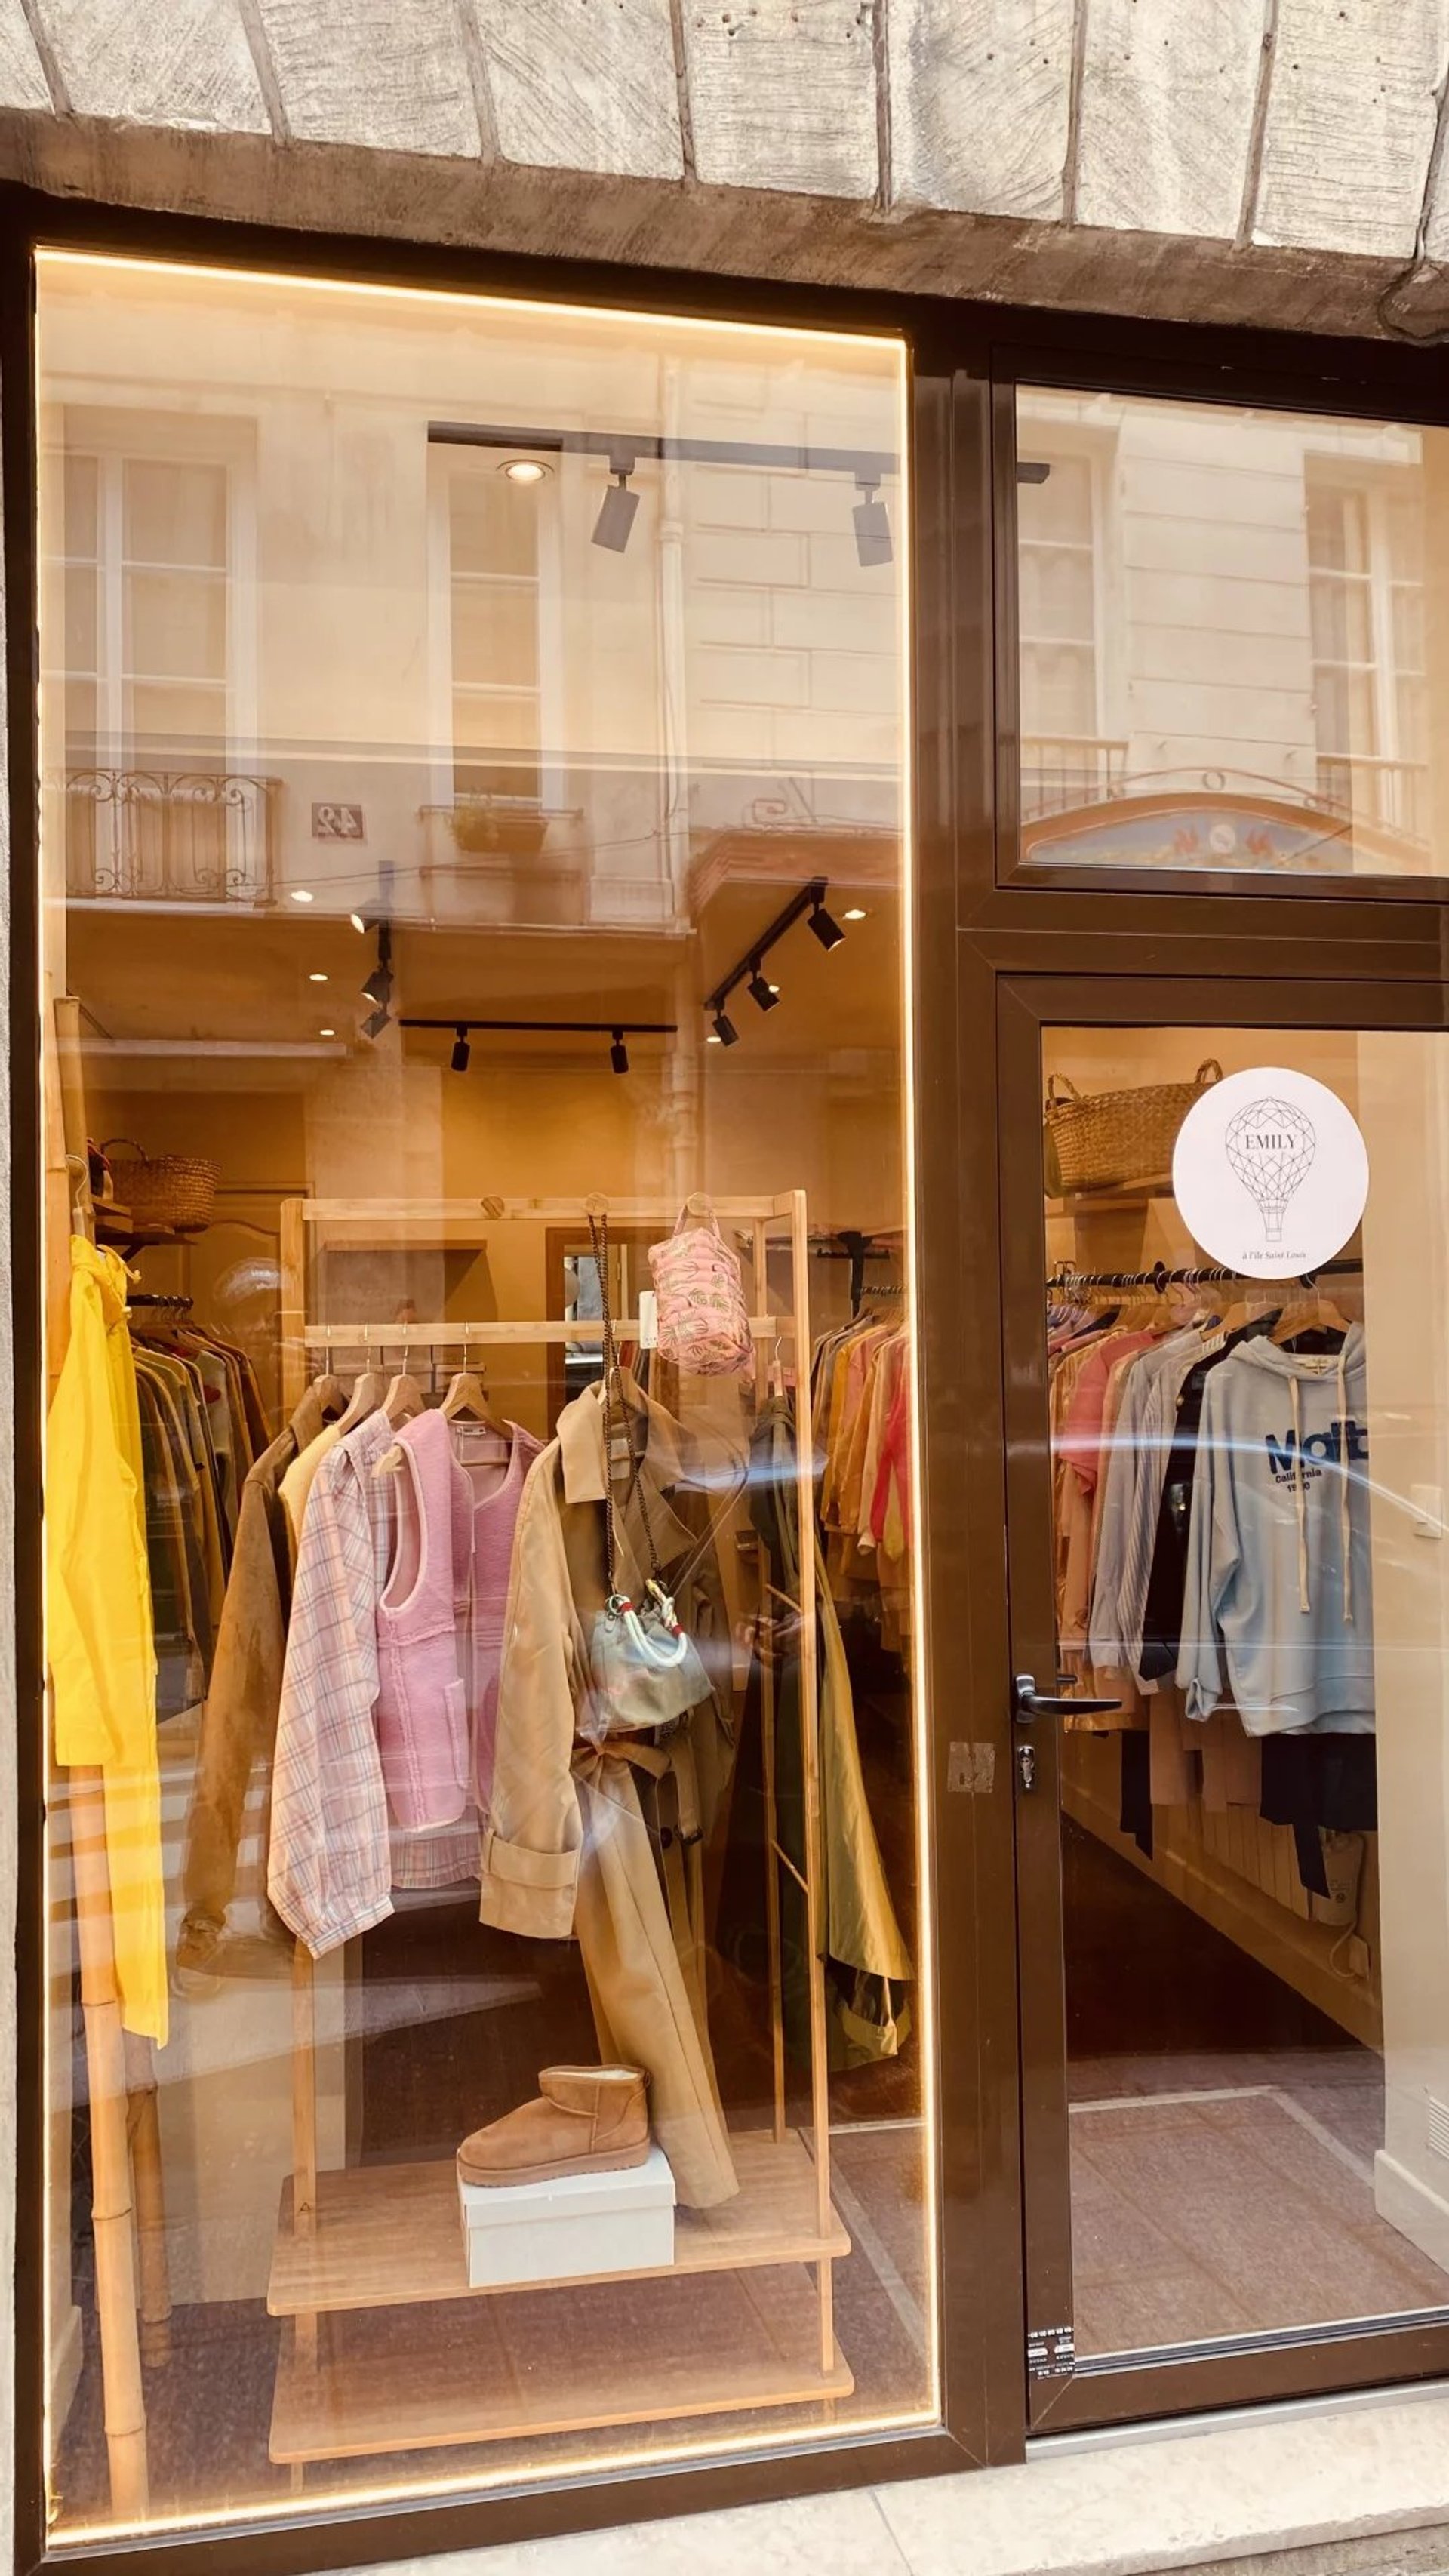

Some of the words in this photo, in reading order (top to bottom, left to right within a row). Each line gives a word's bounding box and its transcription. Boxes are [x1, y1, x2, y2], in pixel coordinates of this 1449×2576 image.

[1246, 1134, 1297, 1149] EMILY
[1265, 1251, 1284, 1259] Saint
[1286, 1251, 1306, 1259] Louis
[1276, 1468, 1321, 1483] Califrnia
[1287, 1482, 1310, 1492] 190
